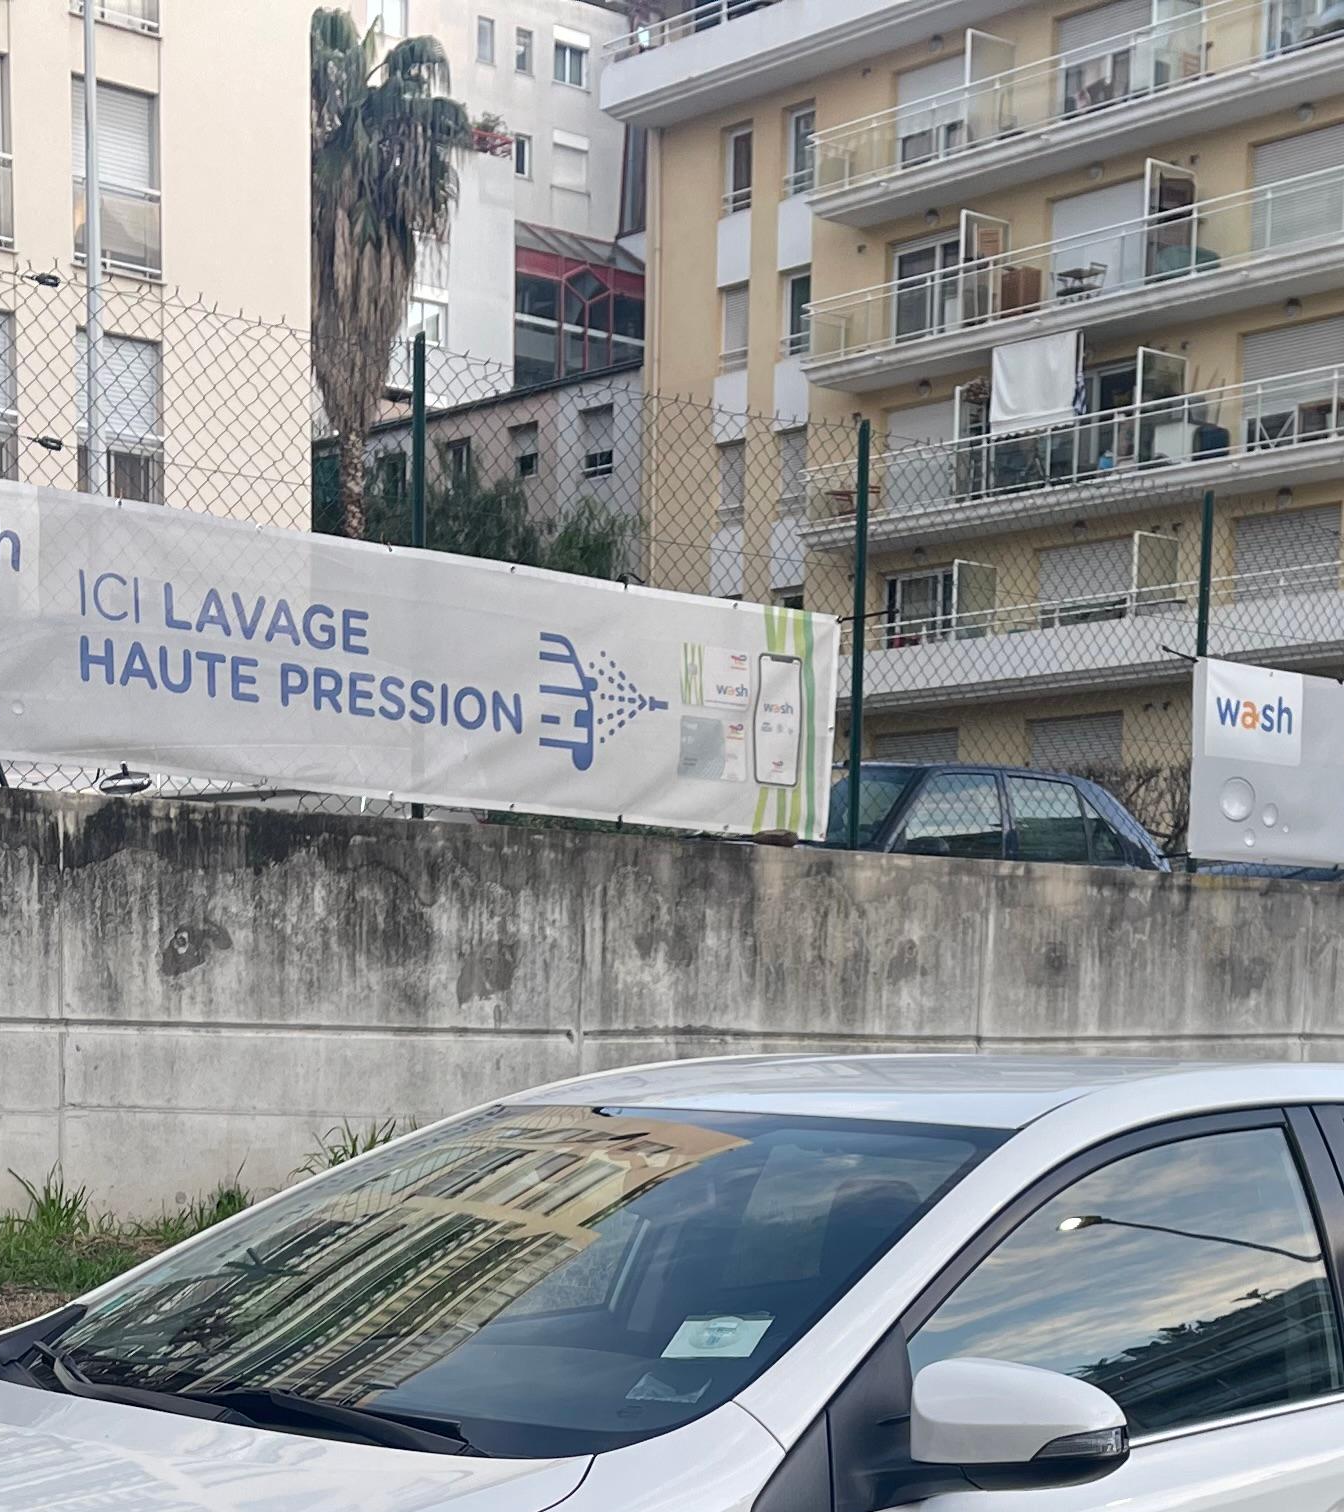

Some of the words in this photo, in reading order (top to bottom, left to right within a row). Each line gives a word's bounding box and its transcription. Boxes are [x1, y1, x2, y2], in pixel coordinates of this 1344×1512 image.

[78, 568, 140, 624] ICI
[164, 582, 370, 656] LAVAGE
[79, 635, 260, 703] HAUTE
[281, 662, 524, 735] PRESSION
[716, 683, 749, 698] wash
[763, 702, 794, 715] wash
[1216, 695, 1293, 736] wash
